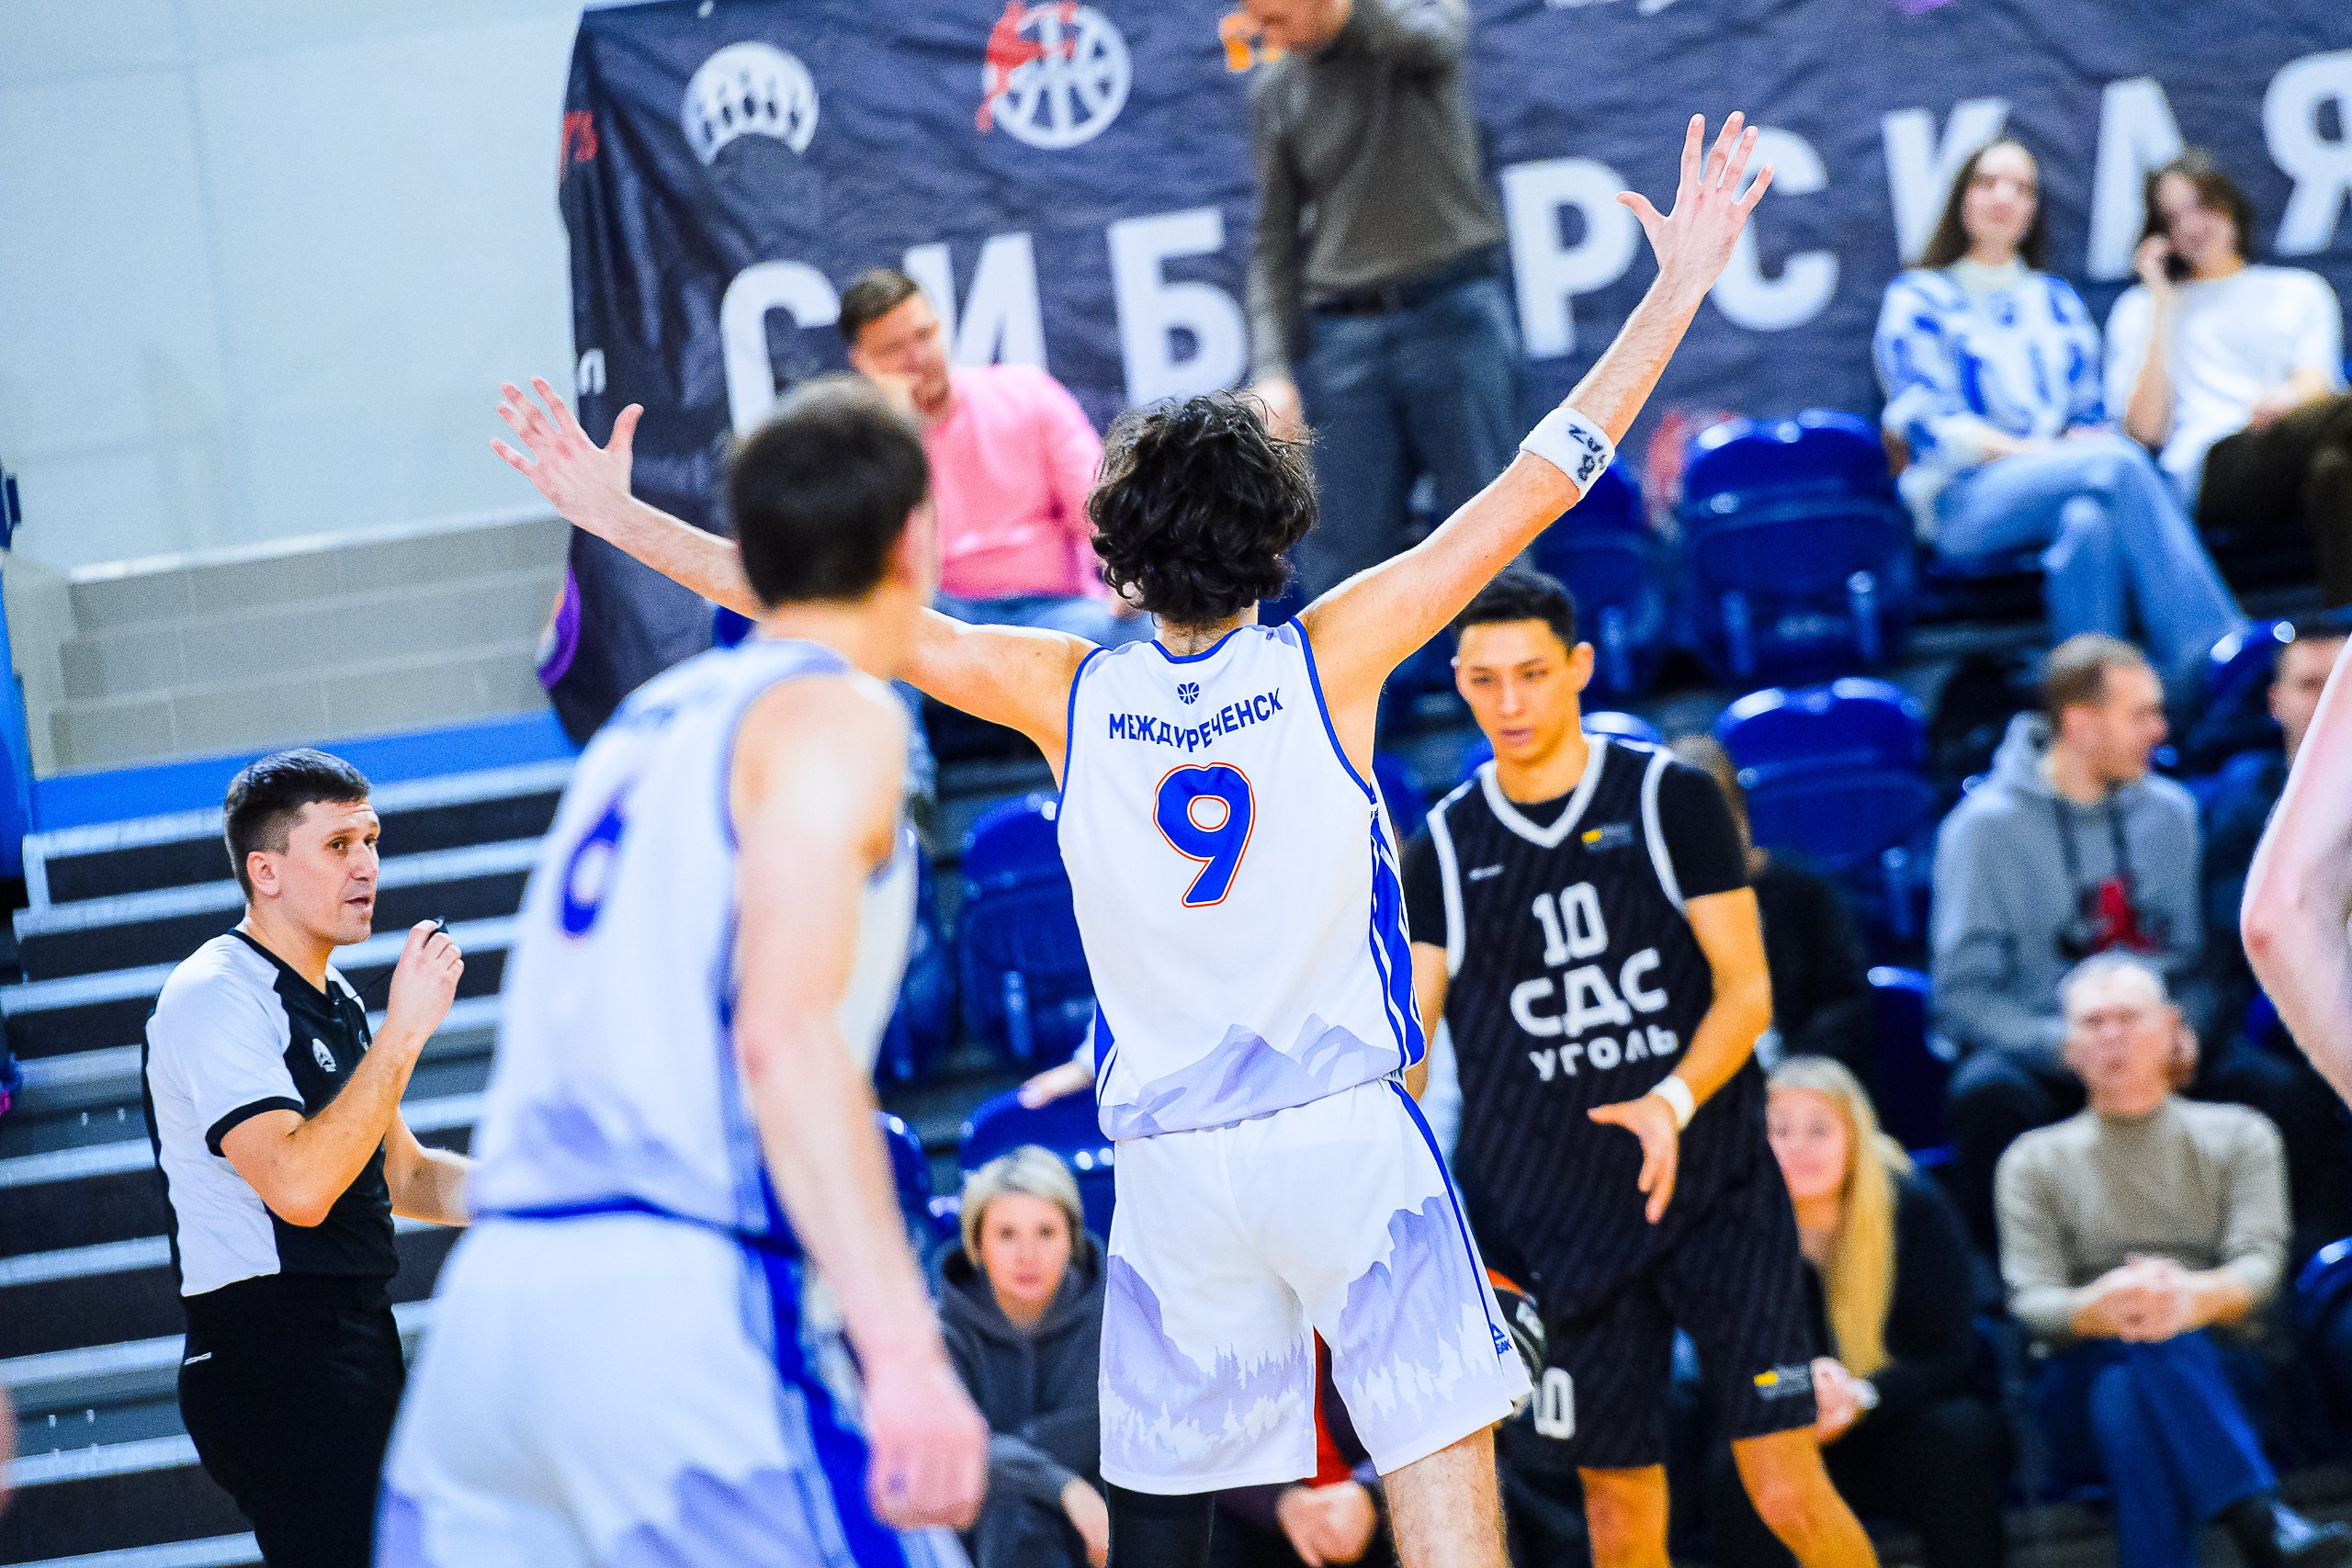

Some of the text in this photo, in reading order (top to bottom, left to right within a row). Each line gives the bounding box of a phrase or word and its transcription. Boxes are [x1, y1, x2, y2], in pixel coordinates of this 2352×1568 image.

[1109, 687, 1283, 753] МЕЖДУРЕЧЕНСК
[1153, 762, 1256, 908] 9
[1532, 881, 1609, 967] 10
[1510, 947, 1668, 1038] СДС
[1527, 1023, 1679, 1082] УГОЛЬ
